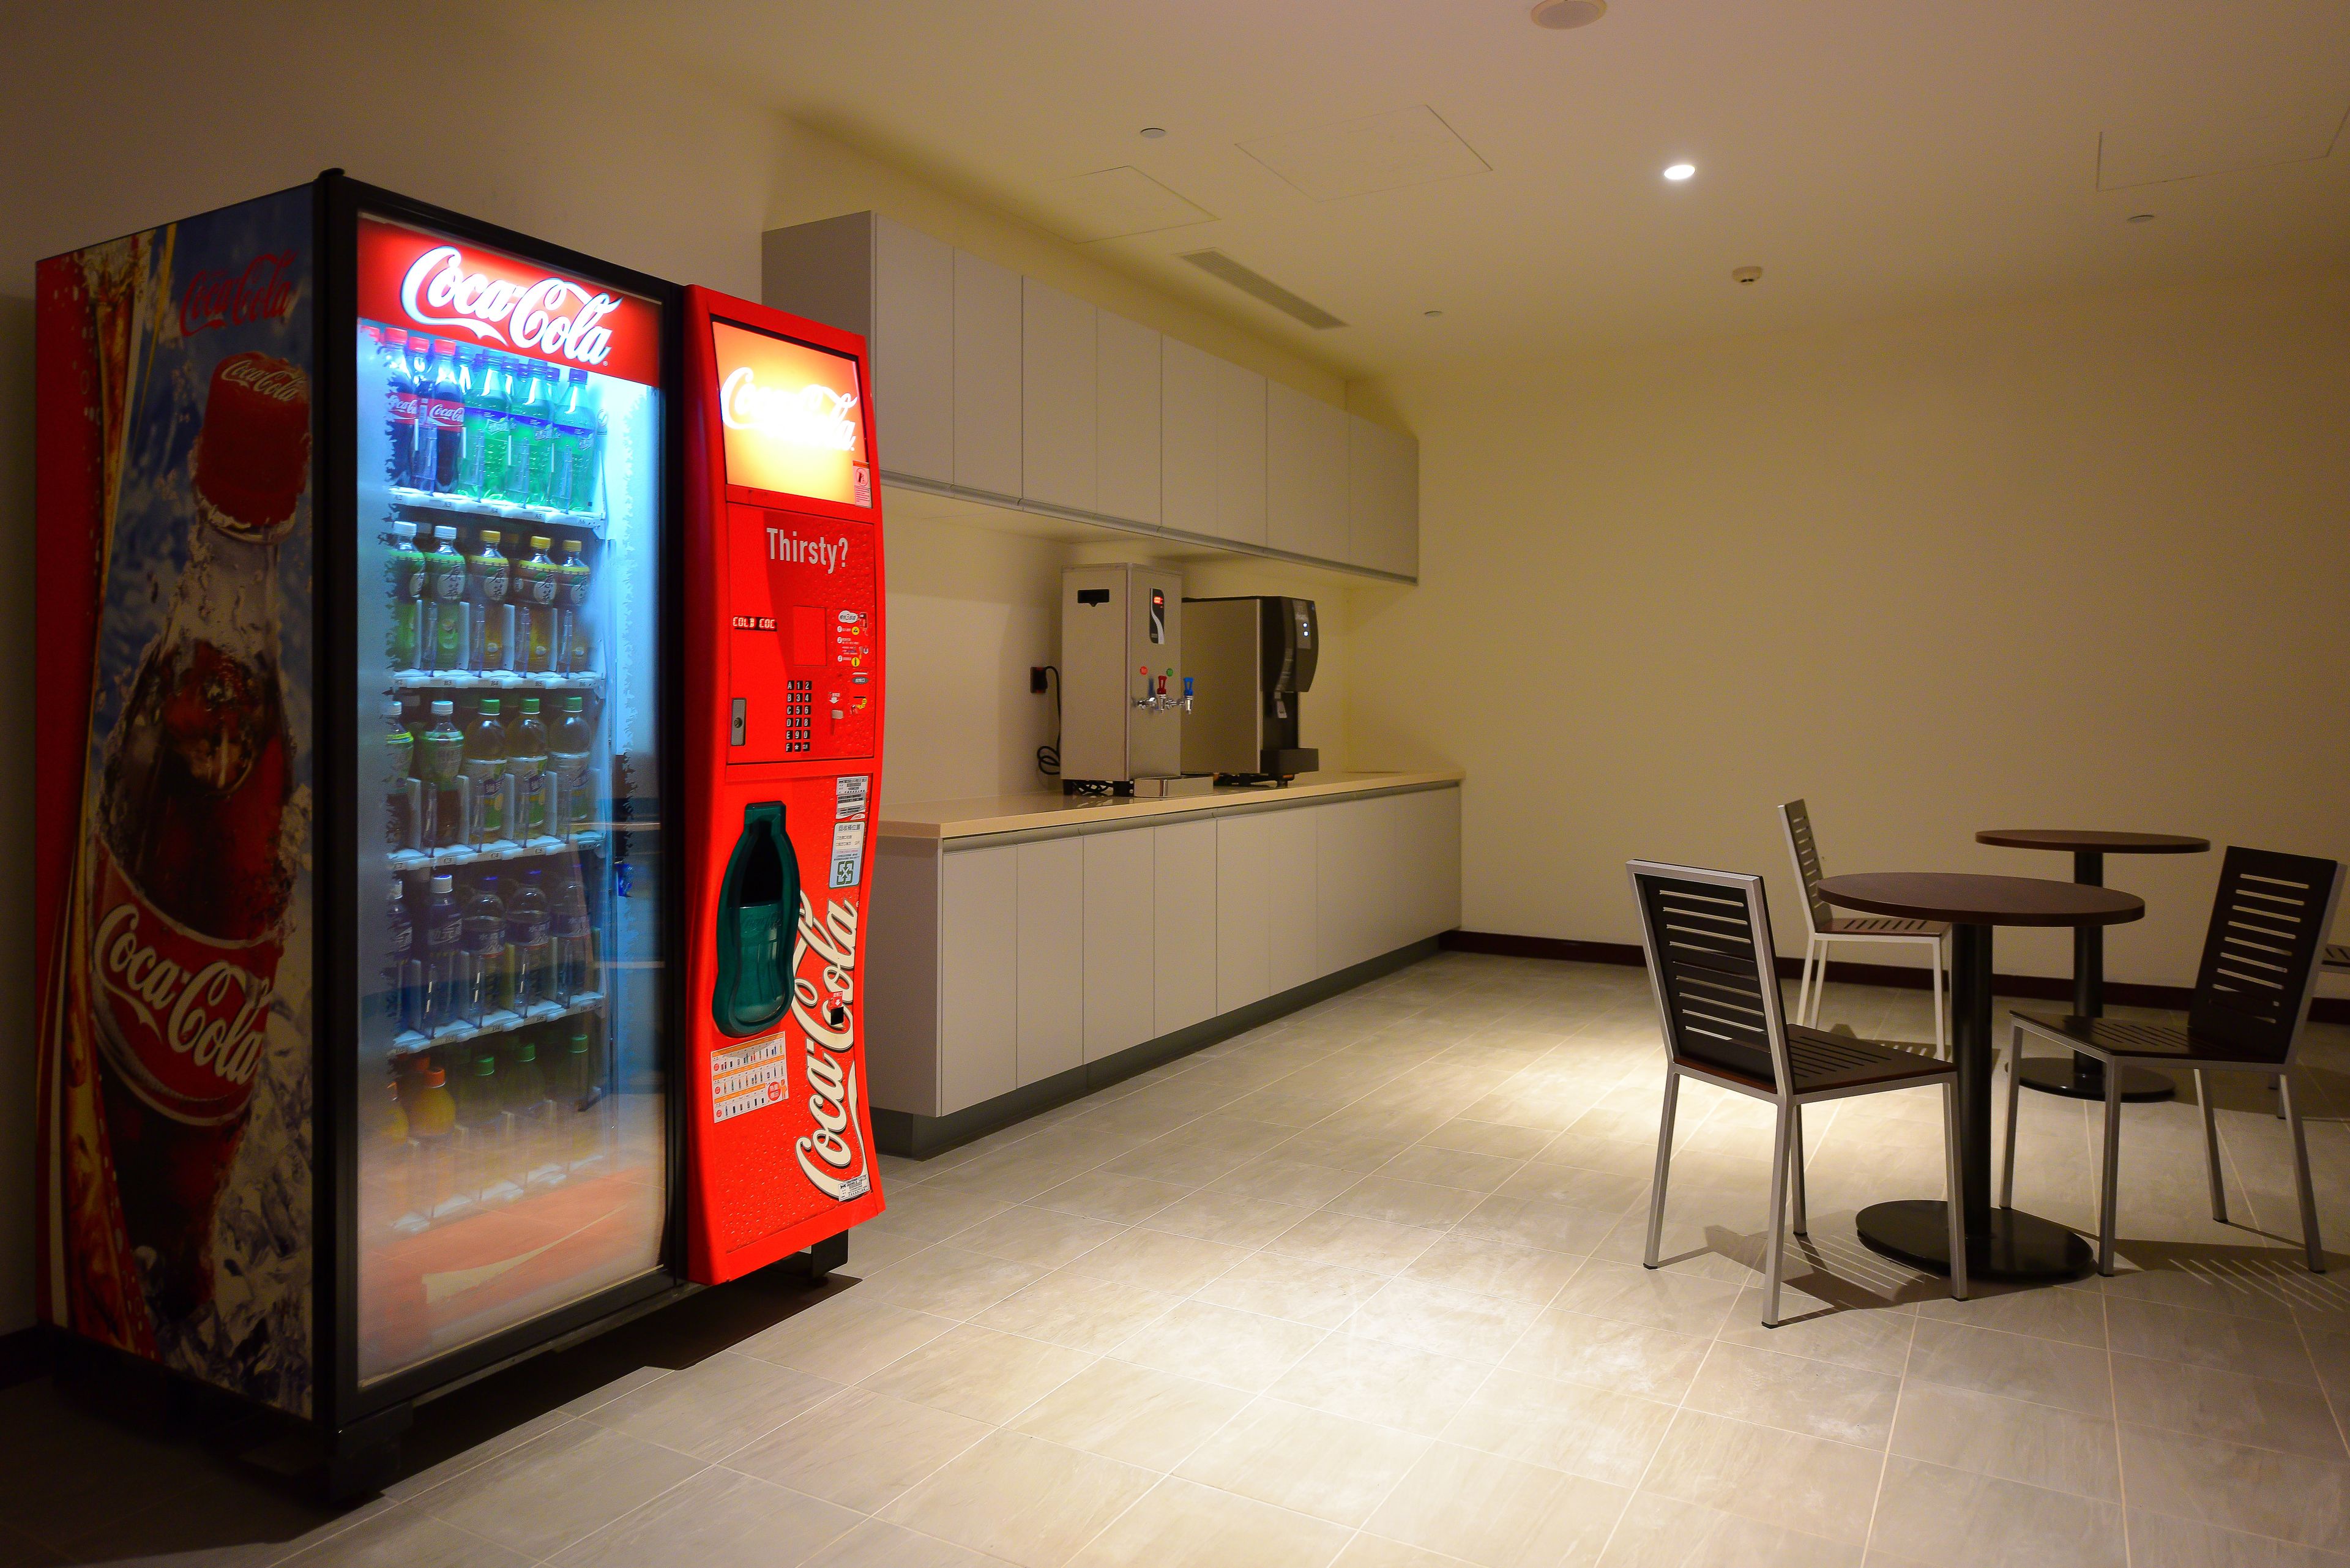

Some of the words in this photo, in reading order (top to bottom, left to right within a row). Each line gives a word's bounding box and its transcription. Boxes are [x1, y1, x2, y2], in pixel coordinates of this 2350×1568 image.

[180, 249, 300, 337] Coca-Cola
[400, 245, 624, 365] Coca-Cola
[220, 360, 304, 401] Coca-Cola
[720, 367, 857, 451] CoCla
[767, 528, 848, 574] Thirsty?
[759, 619, 775, 630] COC
[786, 731, 790, 739] E
[94, 903, 274, 1086] Coca-Cola
[791, 890, 869, 1200] Coca-Cola
